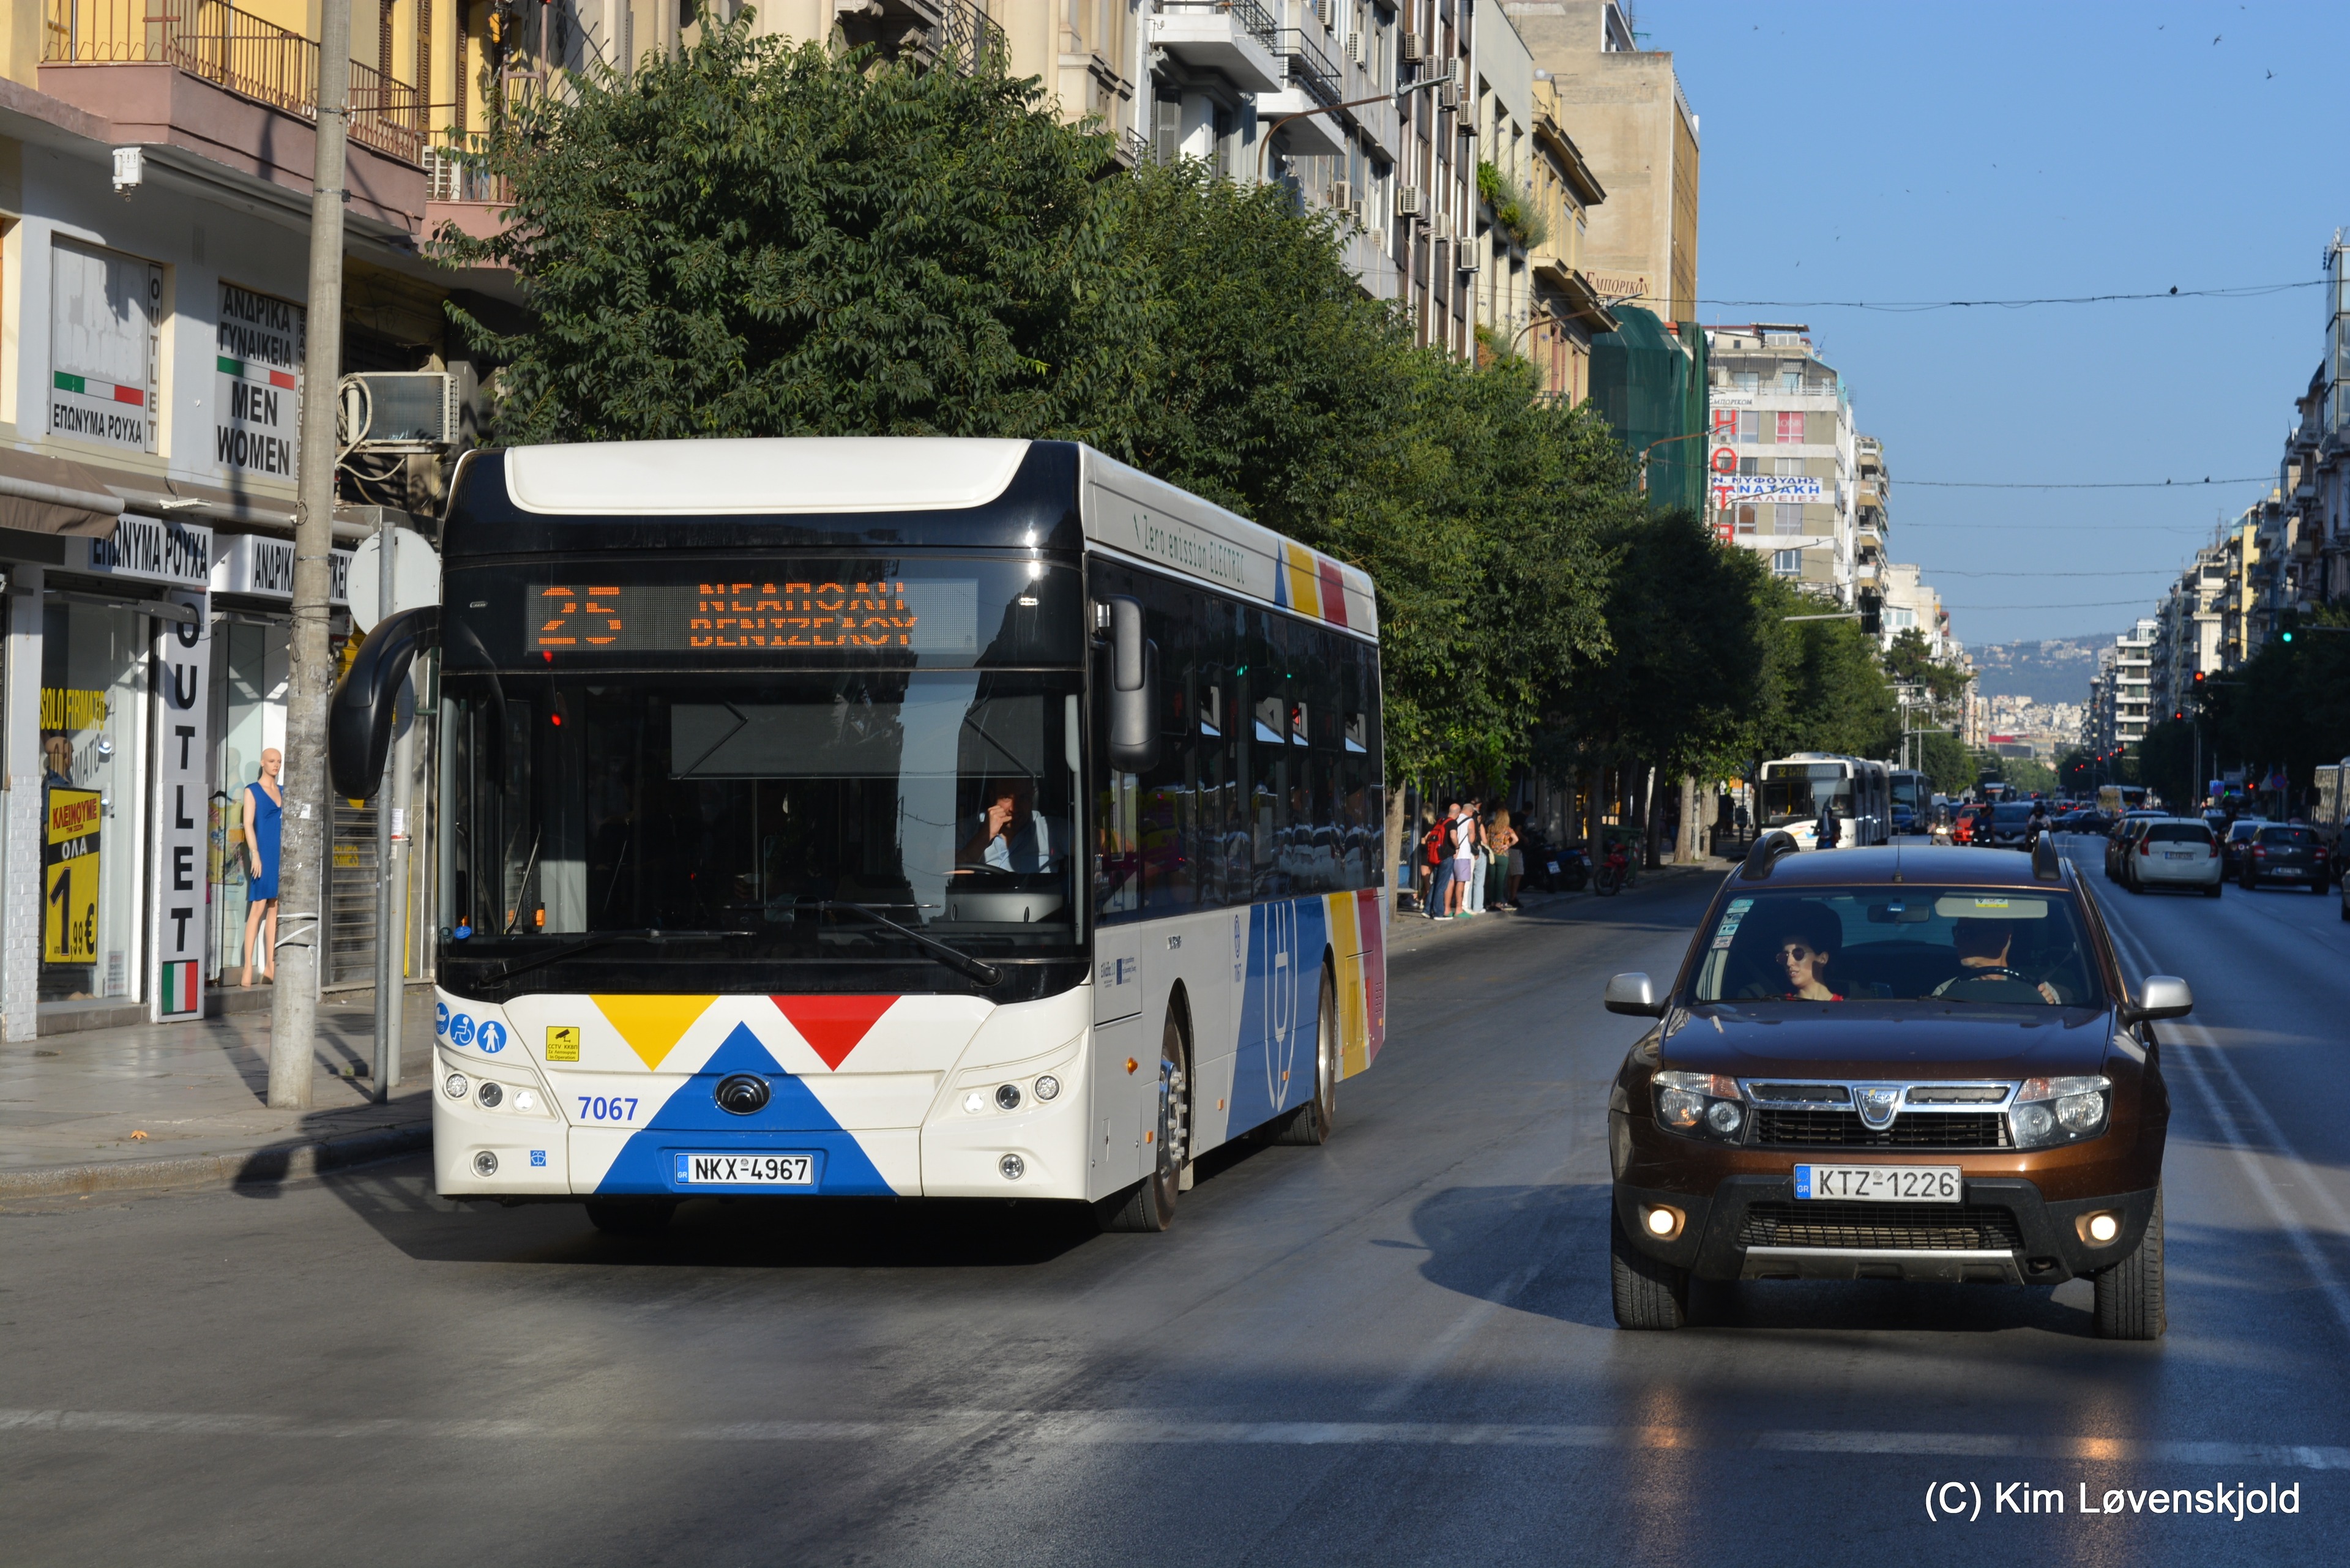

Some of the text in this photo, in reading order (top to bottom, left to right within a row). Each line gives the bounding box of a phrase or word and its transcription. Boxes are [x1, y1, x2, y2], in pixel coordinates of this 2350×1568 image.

[223, 287, 291, 334] ΑΝΔΡΙΚΑ
[148, 278, 160, 442] OUTLET
[220, 321, 292, 370] ΓΥΝΑΙΚΕΙΑ
[54, 404, 142, 444] ΕΠΩΝΥΜΑ ΡΟΥΧΑ
[231, 381, 278, 427] MEN
[217, 425, 290, 476] WOMEN
[165, 528, 208, 580] ΡΟΥΧΑ
[1143, 515, 1245, 585] Zero emission ELECTRIC
[538, 586, 622, 644] 25
[699, 581, 906, 611] ΝΕΑΠΟΛΗ
[40, 687, 105, 731] SOLO FIRMATO
[170, 602, 201, 952] OUTLET
[53, 798, 97, 830] ΚΛΕΙΝΟΥΜΕ
[62, 836, 88, 860] ΟΛΑ
[578, 1096, 638, 1121] 7067
